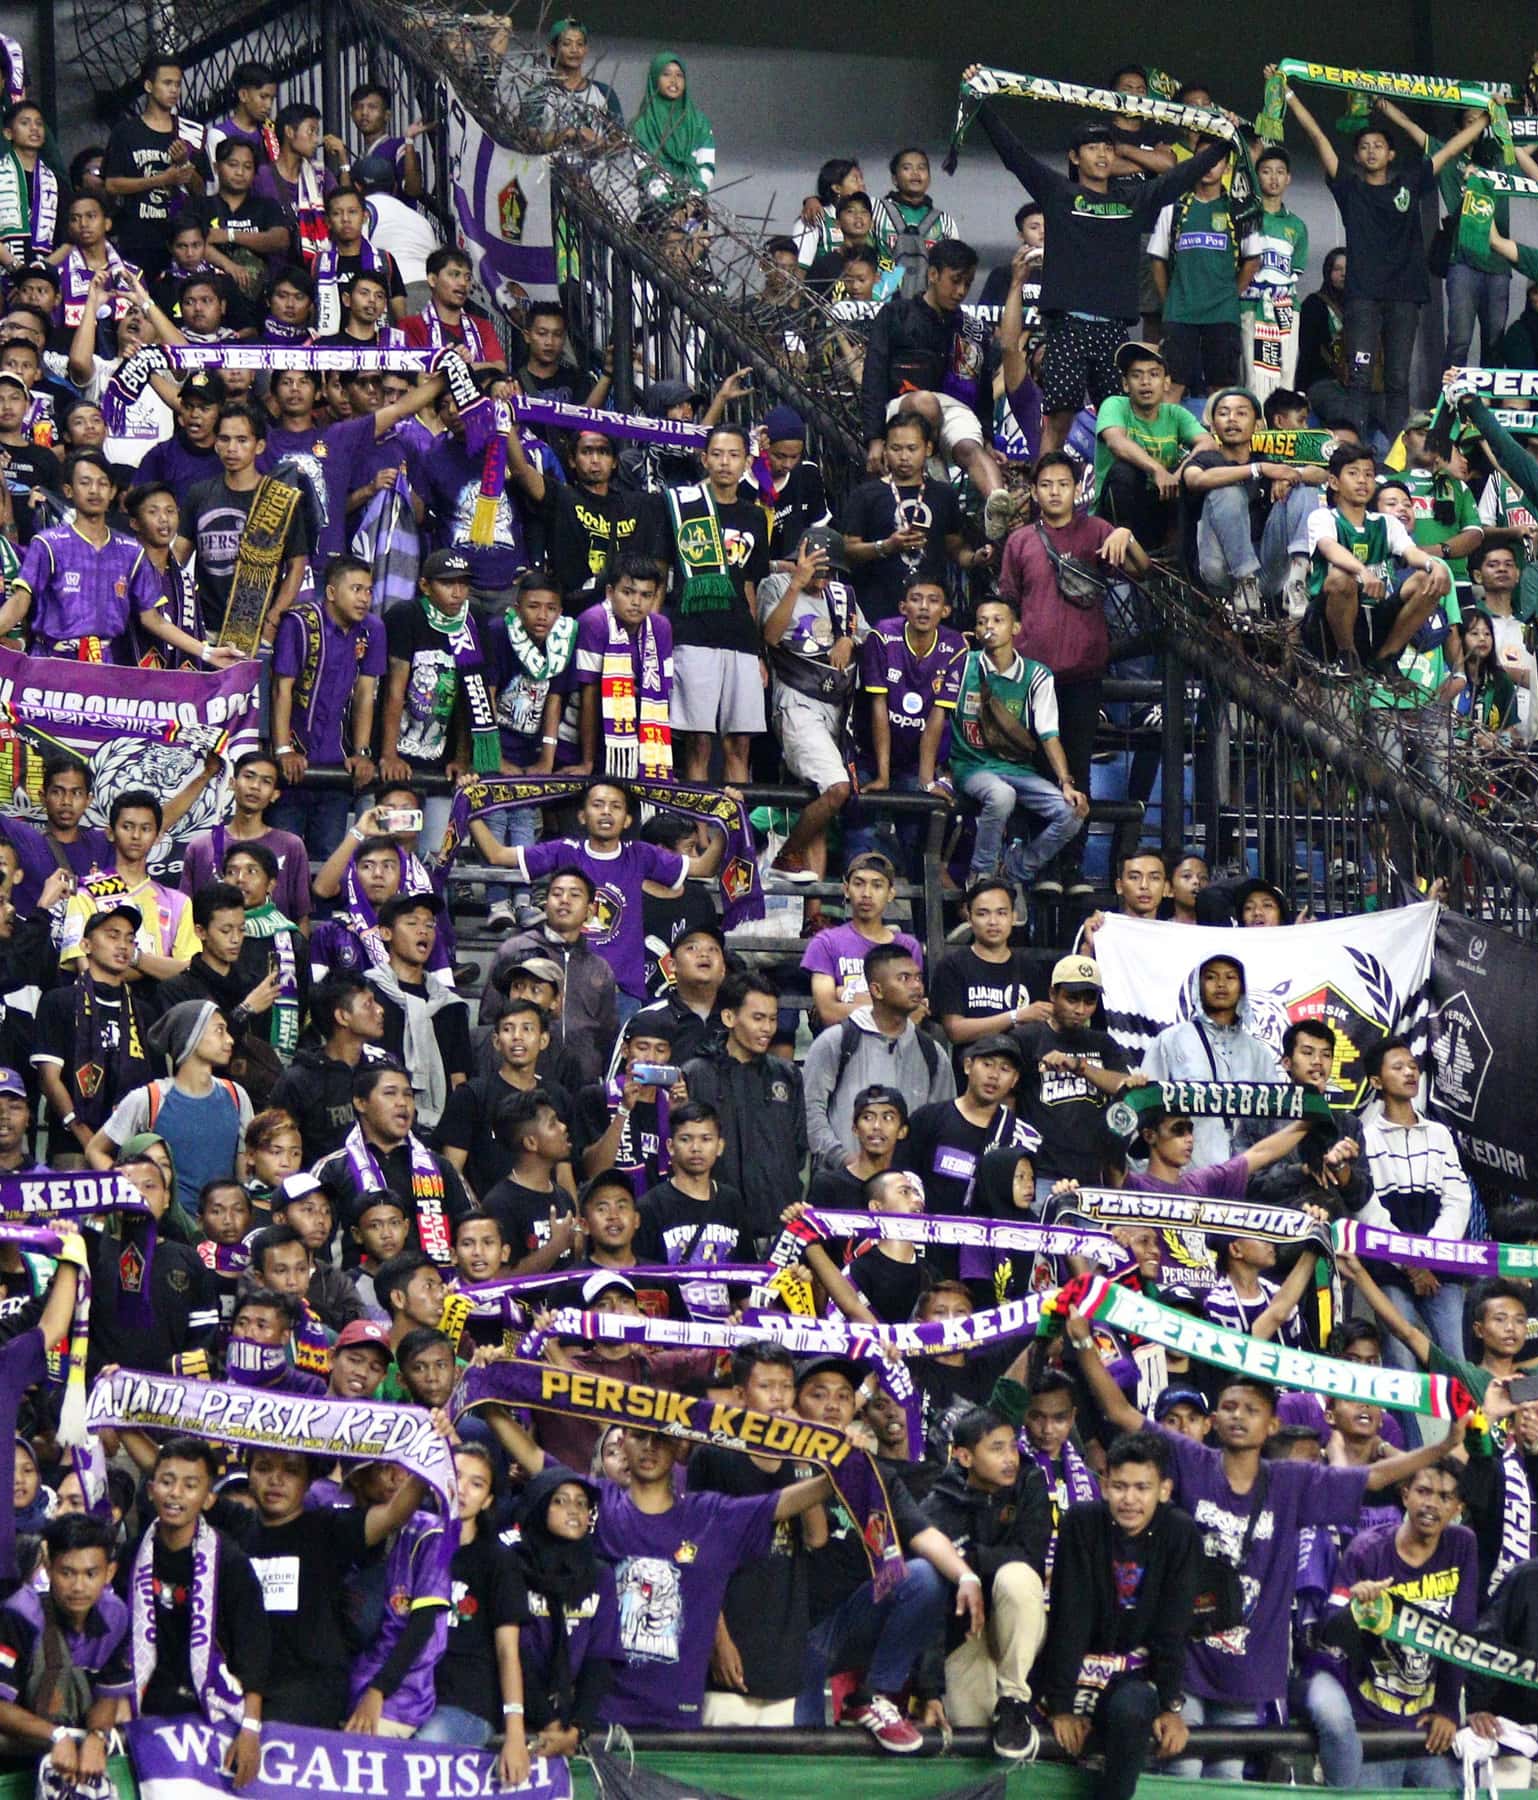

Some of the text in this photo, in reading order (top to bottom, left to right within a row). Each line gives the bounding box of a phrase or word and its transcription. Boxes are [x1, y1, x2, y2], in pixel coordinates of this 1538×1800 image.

[1308, 63, 1461, 100] PERSEBAYA
[180, 347, 430, 372] PERSIK
[1298, 1002, 1349, 1021] PERSIK
[1161, 1082, 1304, 1118] PERSEBAYA
[20, 1176, 148, 1212] KEDIR
[1366, 1234, 1489, 1265] PERSIK
[943, 1290, 1050, 1345] KEDI
[1113, 1290, 1423, 1406] PERSEBAYA
[200, 1389, 330, 1439] PERSIK
[541, 1370, 852, 1468] PERSIK KEDIRI
[191, 1552, 209, 1648] macan
